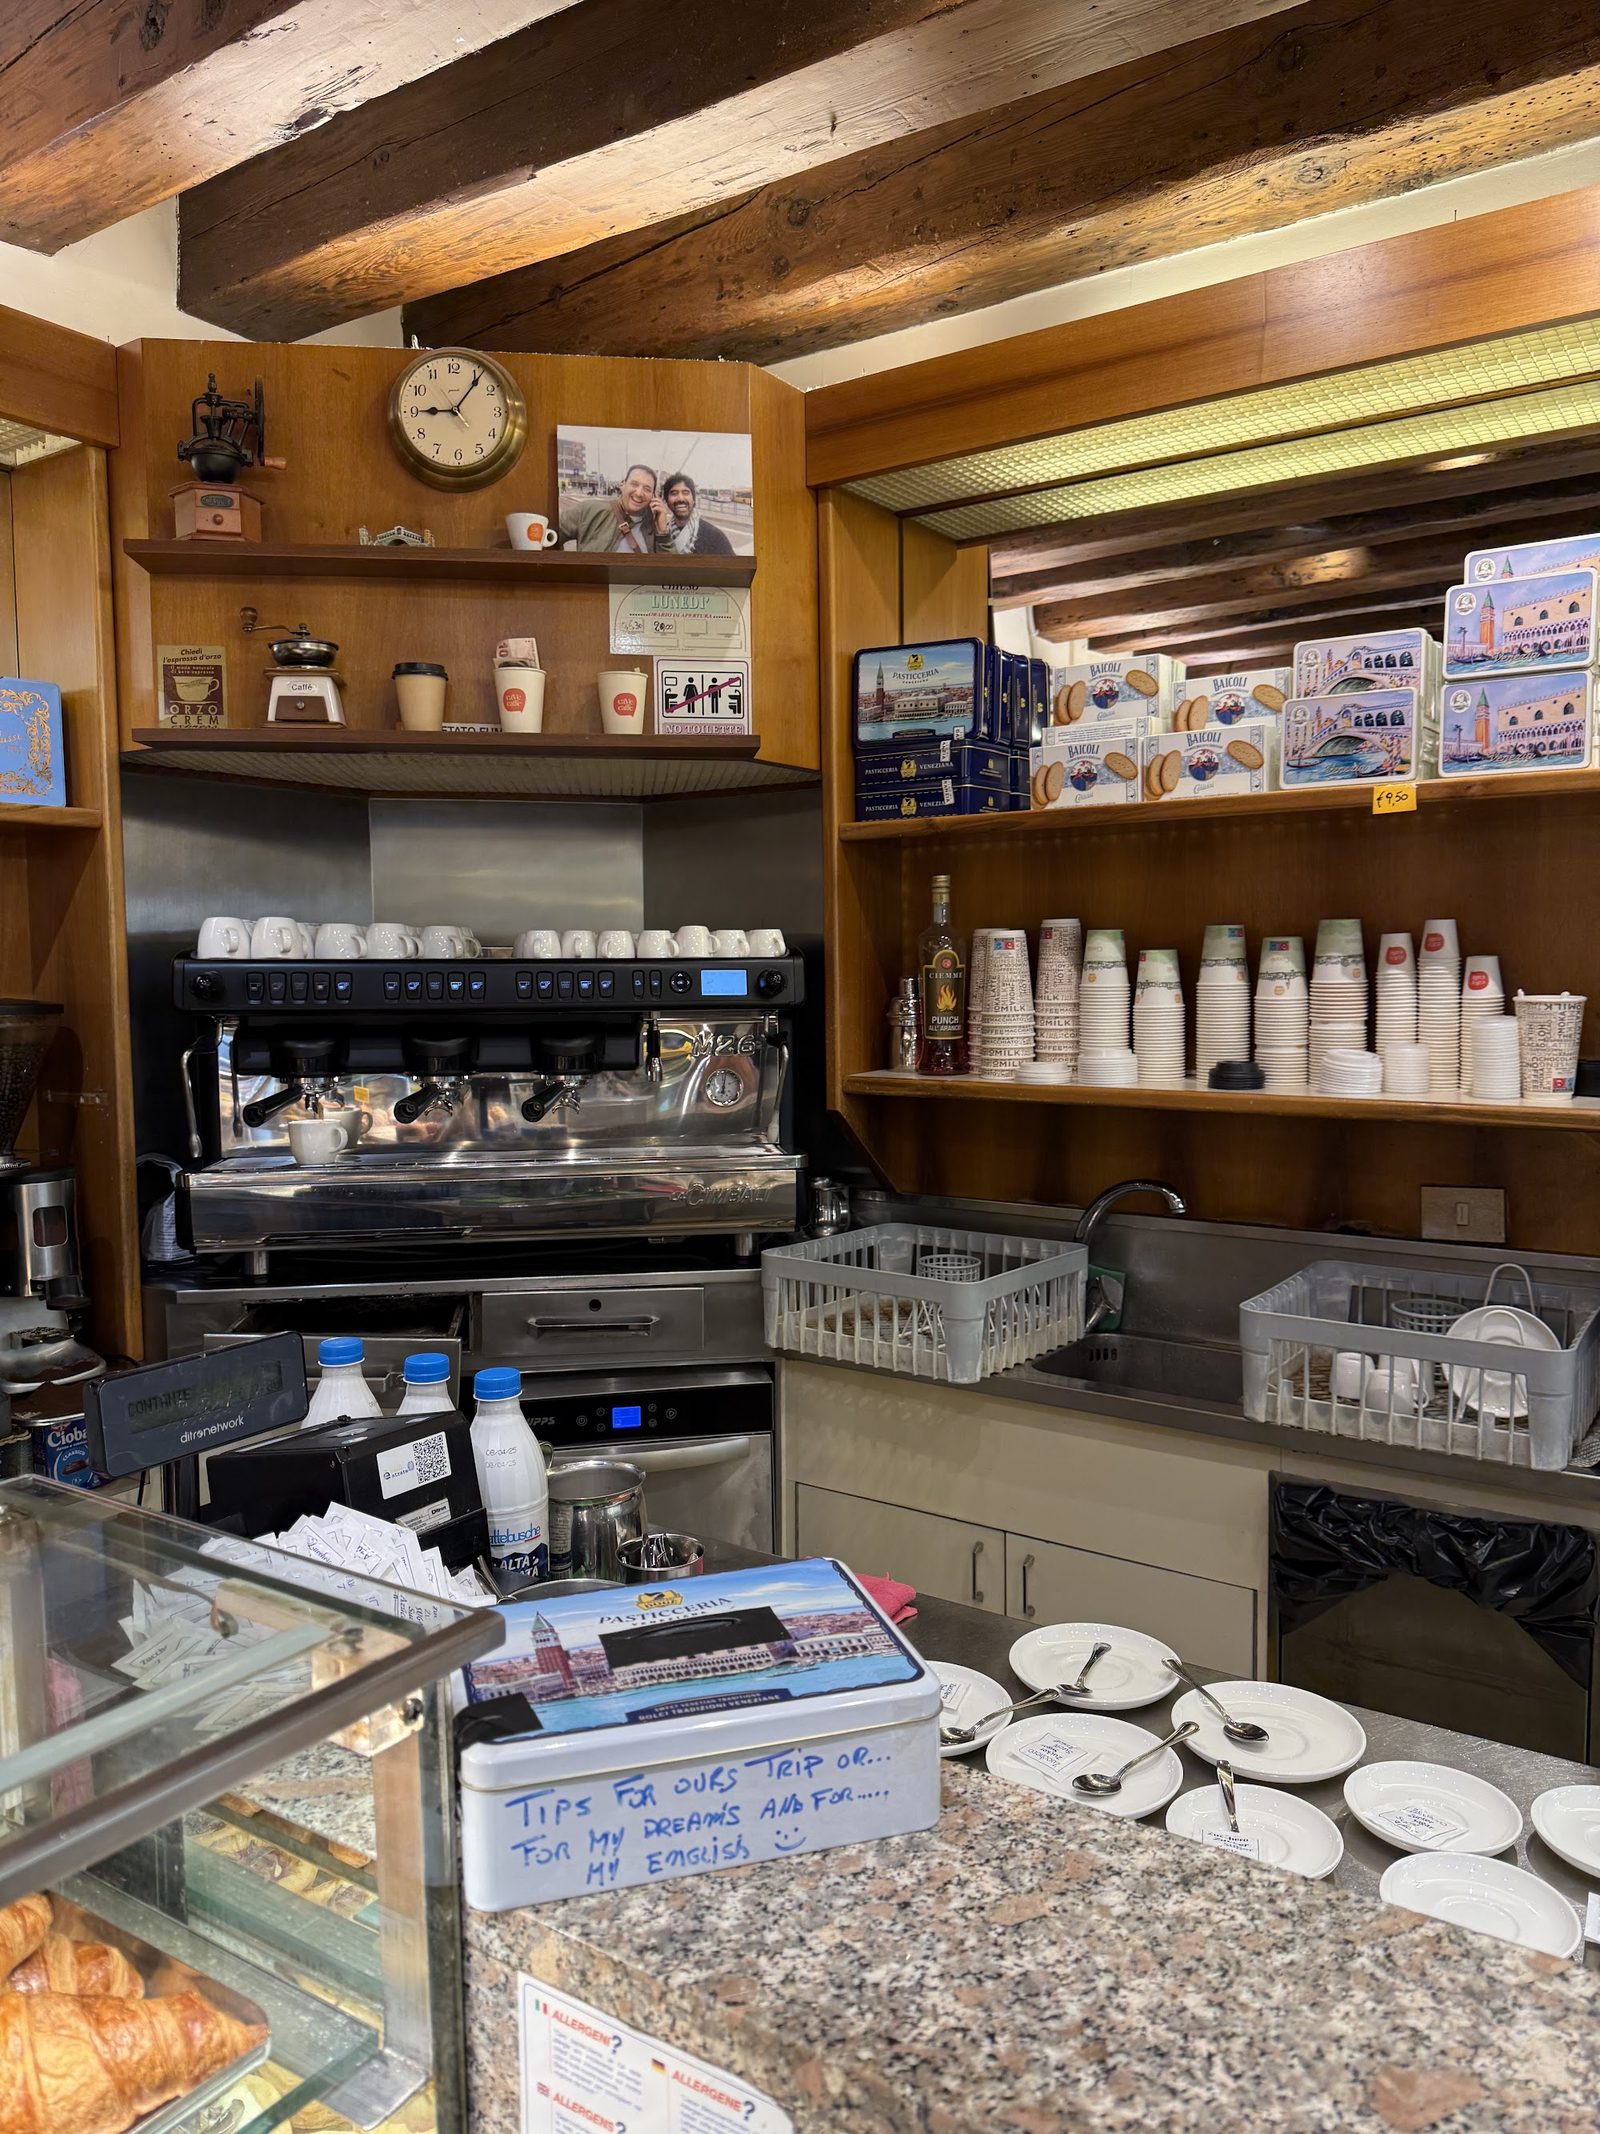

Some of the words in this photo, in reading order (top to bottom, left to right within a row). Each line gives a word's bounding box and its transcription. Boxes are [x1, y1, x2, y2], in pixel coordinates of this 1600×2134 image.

[447, 362, 461, 374] 12
[428, 369, 437, 380] 11
[413, 384, 427, 397] 10
[486, 384, 496, 396] 2
[410, 406, 419, 418] 9
[493, 406, 502, 418] 3
[417, 427, 426, 440] 8
[488, 427, 497, 439] 4
[433, 443, 442, 455] 7
[454, 448, 463, 460] 6
[474, 443, 484, 455] 5
[180, 647, 203, 656] Chiedi
[892, 667, 940, 680] PASTICCERIA
[1089, 662, 1122, 677] BAICOLI
[1213, 676, 1248, 692] BAICOLI
[169, 704, 218, 715] ORZO
[170, 715, 219, 725] CREM
[665, 724, 682, 734] NO
[685, 725, 743, 734] TOILETTE
[1186, 732, 1222, 747] BAICOLI
[1067, 744, 1100, 758] BAICOLI
[865, 766, 898, 775] PASTICCERIA
[919, 762, 954, 770] VENEZIANA
[865, 804, 898, 812] PASTICCERIA
[931, 1016, 959, 1025] PUNCH
[180, 1415, 245, 1444] ditronetwork
[499, 1555, 530, 1571] ALTA
[599, 1597, 732, 1624] PASTICCERIA
[638, 1711, 669, 1722] DOLCI
[672, 1703, 727, 1716] TRADIZIONI
[729, 1695, 780, 1707] VENEZIANE
[505, 1788, 592, 1828] TIPS
[613, 1773, 657, 1810] FOR
[674, 1766, 738, 1794] OURS
[511, 1834, 571, 1867] FOR
[588, 1826, 625, 1858] MY
[586, 1857, 620, 1887] MY
